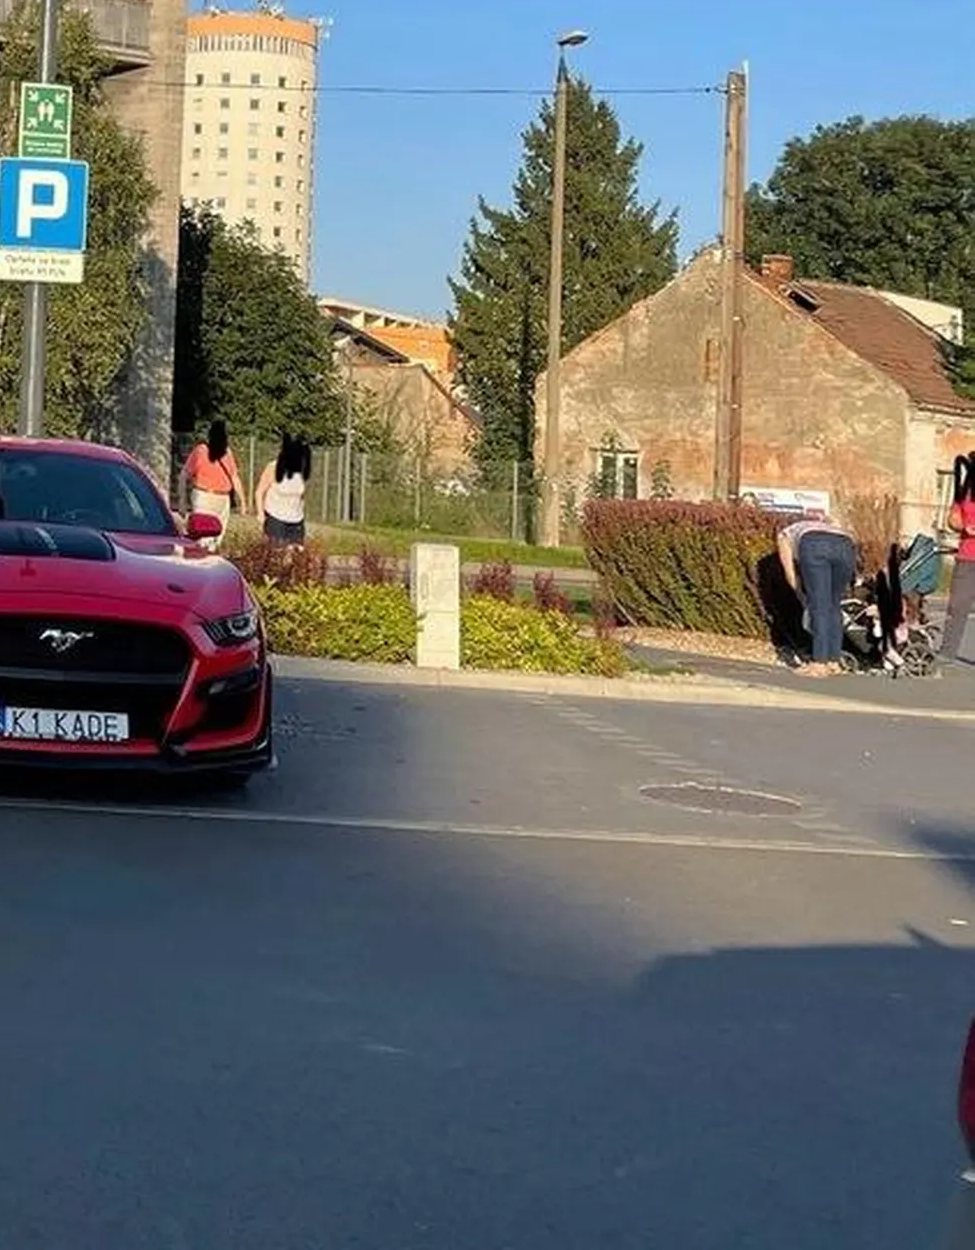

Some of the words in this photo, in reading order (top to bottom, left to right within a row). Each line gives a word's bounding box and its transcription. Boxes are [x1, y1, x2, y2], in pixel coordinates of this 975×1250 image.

[16, 169, 68, 238] P
[12, 710, 39, 734] K1
[54, 712, 118, 737] KADE
